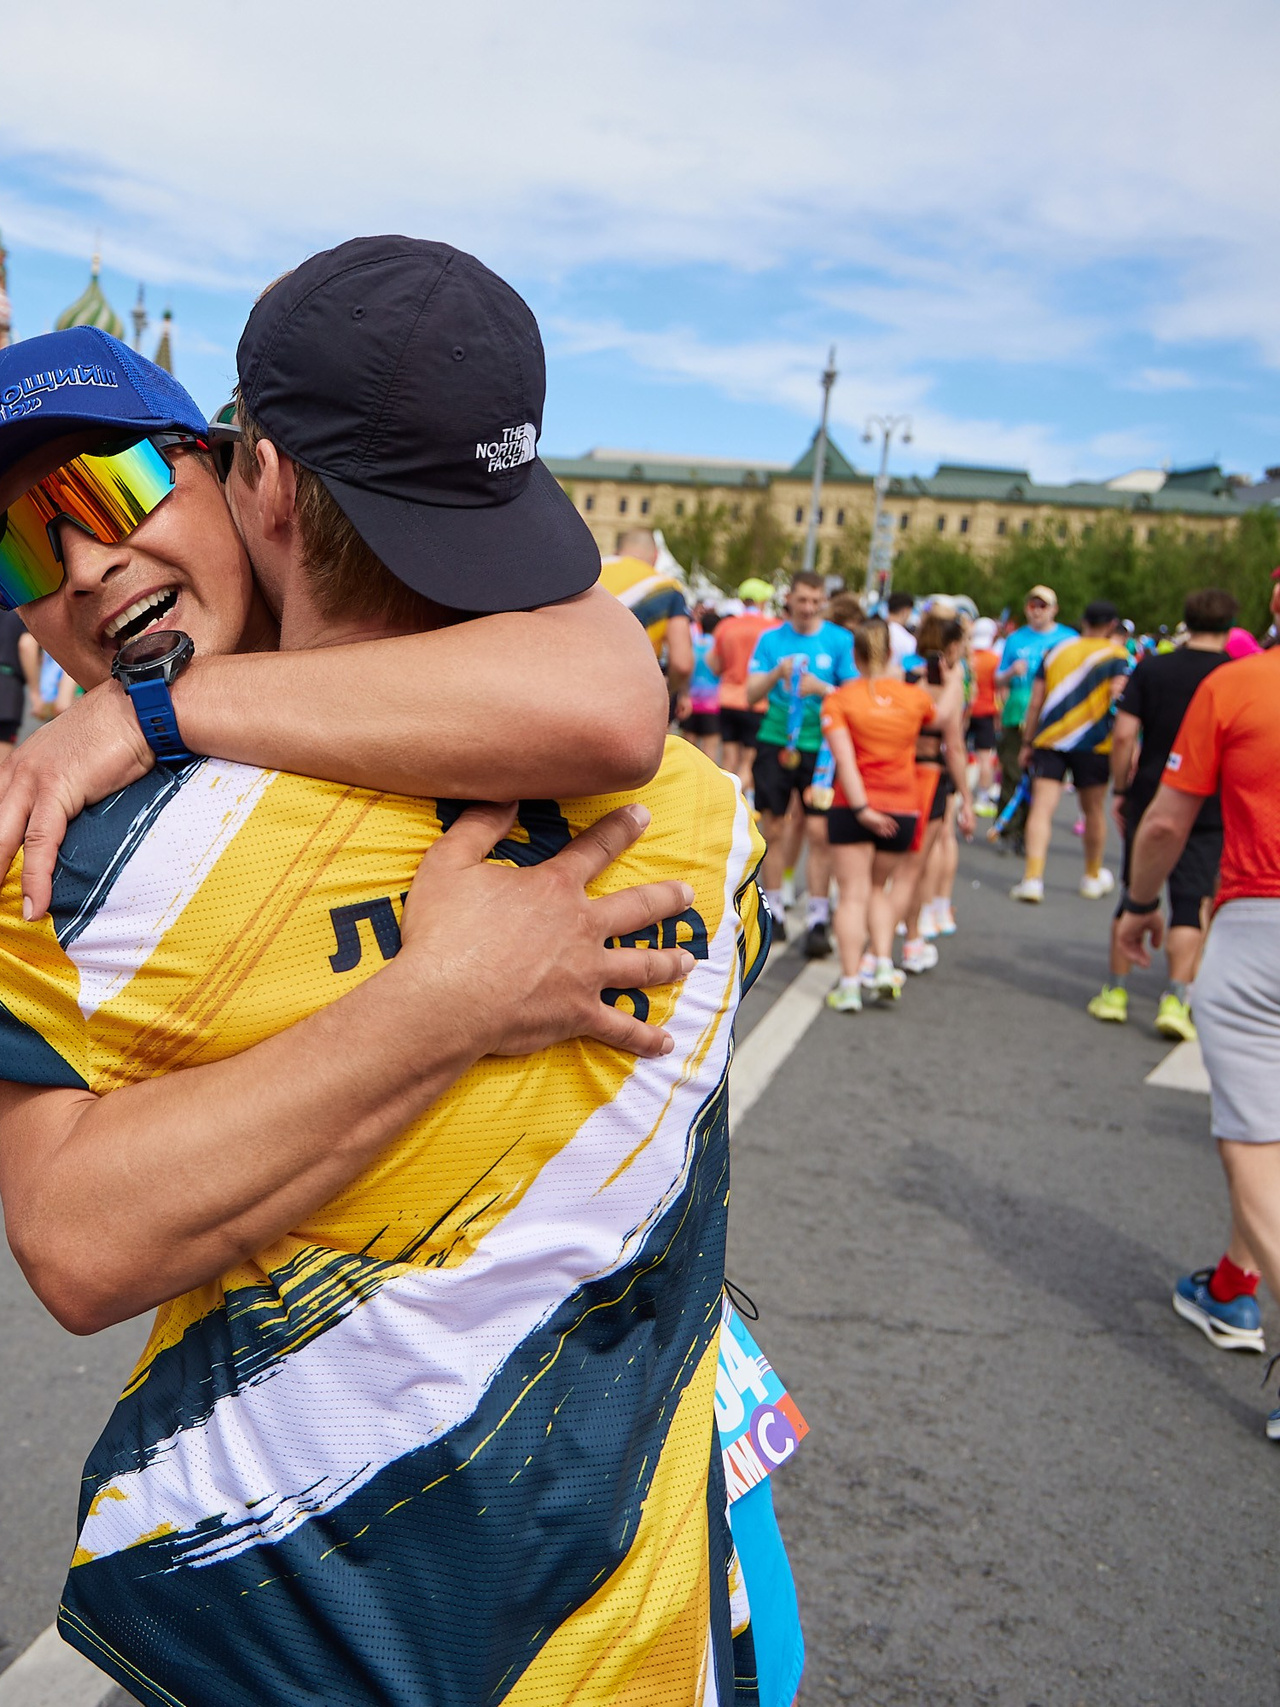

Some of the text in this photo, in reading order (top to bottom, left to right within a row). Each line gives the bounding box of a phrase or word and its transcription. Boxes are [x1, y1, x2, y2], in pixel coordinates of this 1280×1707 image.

[502, 424, 525, 442] THE
[475, 440, 523, 459] NORTH
[487, 454, 521, 473] FACE
[757, 1411, 794, 1465] C
